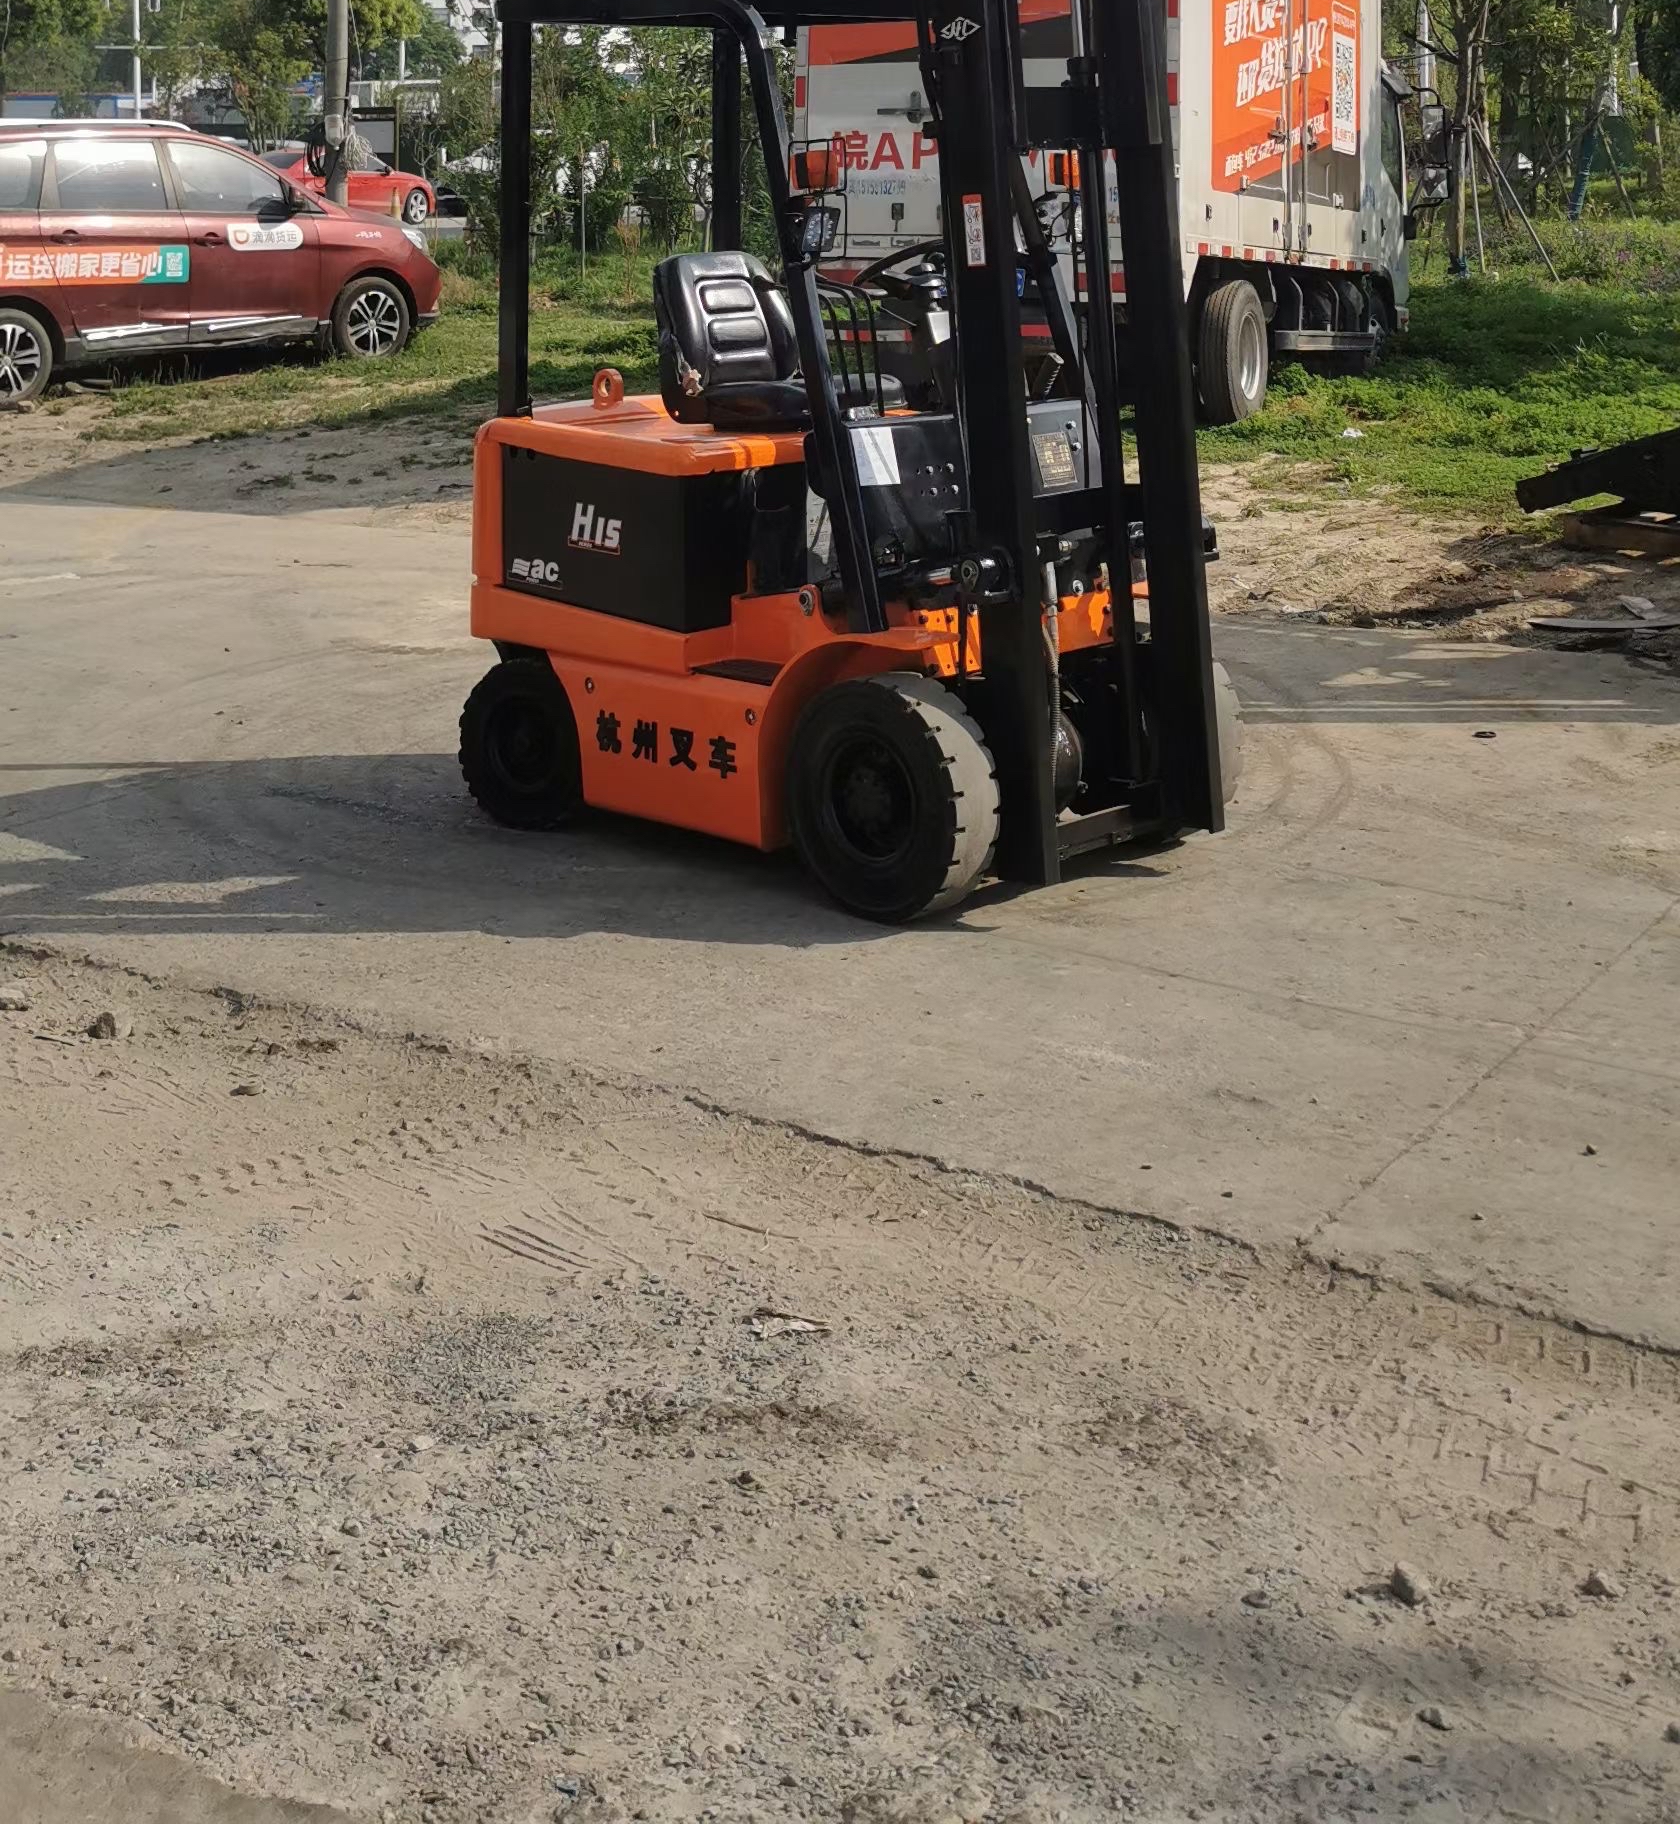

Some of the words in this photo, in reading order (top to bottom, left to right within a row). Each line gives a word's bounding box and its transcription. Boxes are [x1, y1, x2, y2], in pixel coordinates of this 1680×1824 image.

[5, 251, 163, 281] 运货搬家更省心
[596, 709, 738, 779] 杭州叉车
